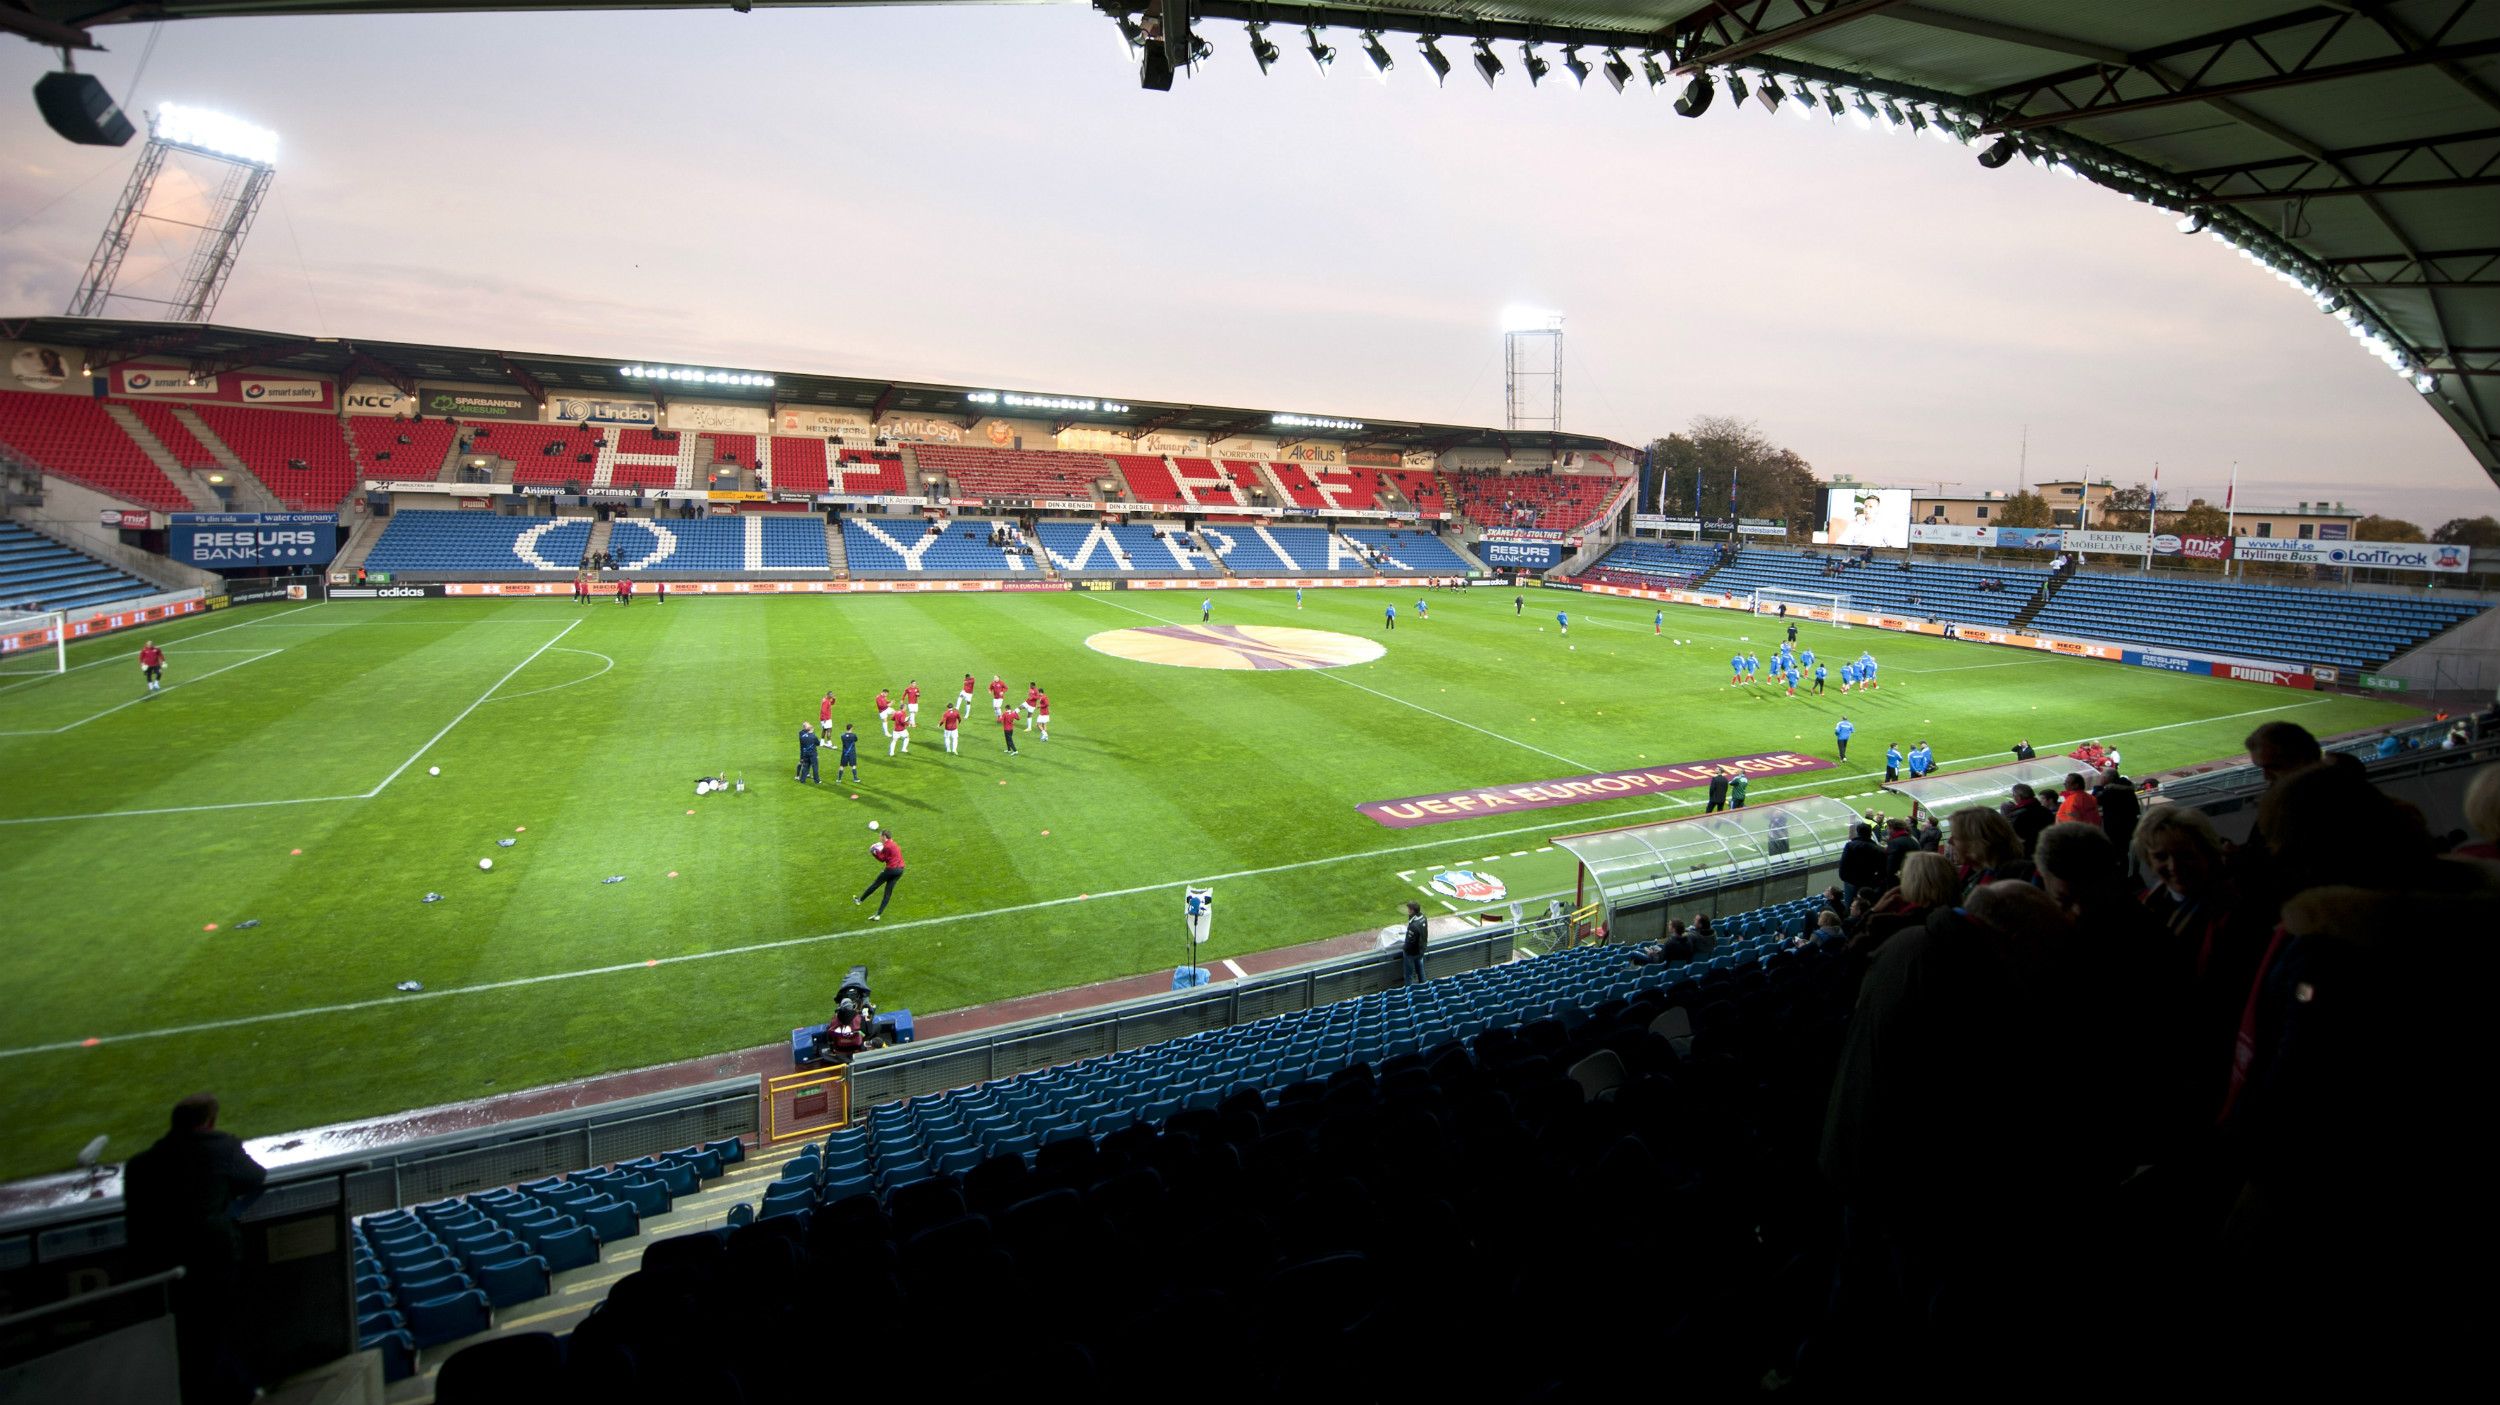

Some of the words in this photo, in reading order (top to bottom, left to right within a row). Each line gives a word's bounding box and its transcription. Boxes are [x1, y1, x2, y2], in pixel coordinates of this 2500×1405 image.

[154, 378, 182, 387] smart
[183, 377, 210, 389] sety
[268, 388, 291, 397] smart
[292, 387, 316, 398] safety
[347, 395, 392, 409] NCC
[455, 397, 522, 409] SPARBANKEN
[459, 405, 508, 415] ÖRESUND
[595, 405, 651, 421] Lindab
[818, 416, 855, 426] OLYMPIA
[806, 425, 868, 435] HELSINGBORG
[879, 420, 961, 442] RAMLÖSA
[1219, 449, 1270, 460] NORRPORTEN
[1288, 445, 1336, 462] Akelius
[1406, 456, 1427, 466] NCC
[586, 488, 638, 497] OPTIMERA
[264, 514, 290, 522] water
[292, 514, 332, 524] company
[1526, 530, 1563, 539] STOLTHET
[1739, 526, 1785, 535] Handelsbanken
[193, 531, 316, 547] RESURS
[2088, 533, 2126, 542] EKEBY
[1489, 545, 1550, 556] RESURS
[2070, 540, 2144, 552] MÖBELAFFÄR
[2184, 538, 2226, 554] mix
[2248, 539, 2315, 551] www.hif.se
[193, 547, 265, 561] BANK
[1489, 554, 1523, 563] BANK
[2184, 550, 2221, 560] MEGAPOL
[2240, 549, 2289, 562] Hyllinge
[2290, 550, 2319, 562] Buss
[378, 587, 425, 597] adidas
[1964, 629, 1986, 637] HECO
[2057, 642, 2082, 650] HECO
[2141, 660, 2168, 670] BANK
[2142, 654, 2189, 667] RESURS
[2230, 666, 2275, 684] PUMA
[2367, 676, 2400, 689] SEB
[1379, 789, 1512, 820] UEFA
[1510, 766, 1677, 804] EUROPA
[1670, 752, 1815, 781] LEAGUE
